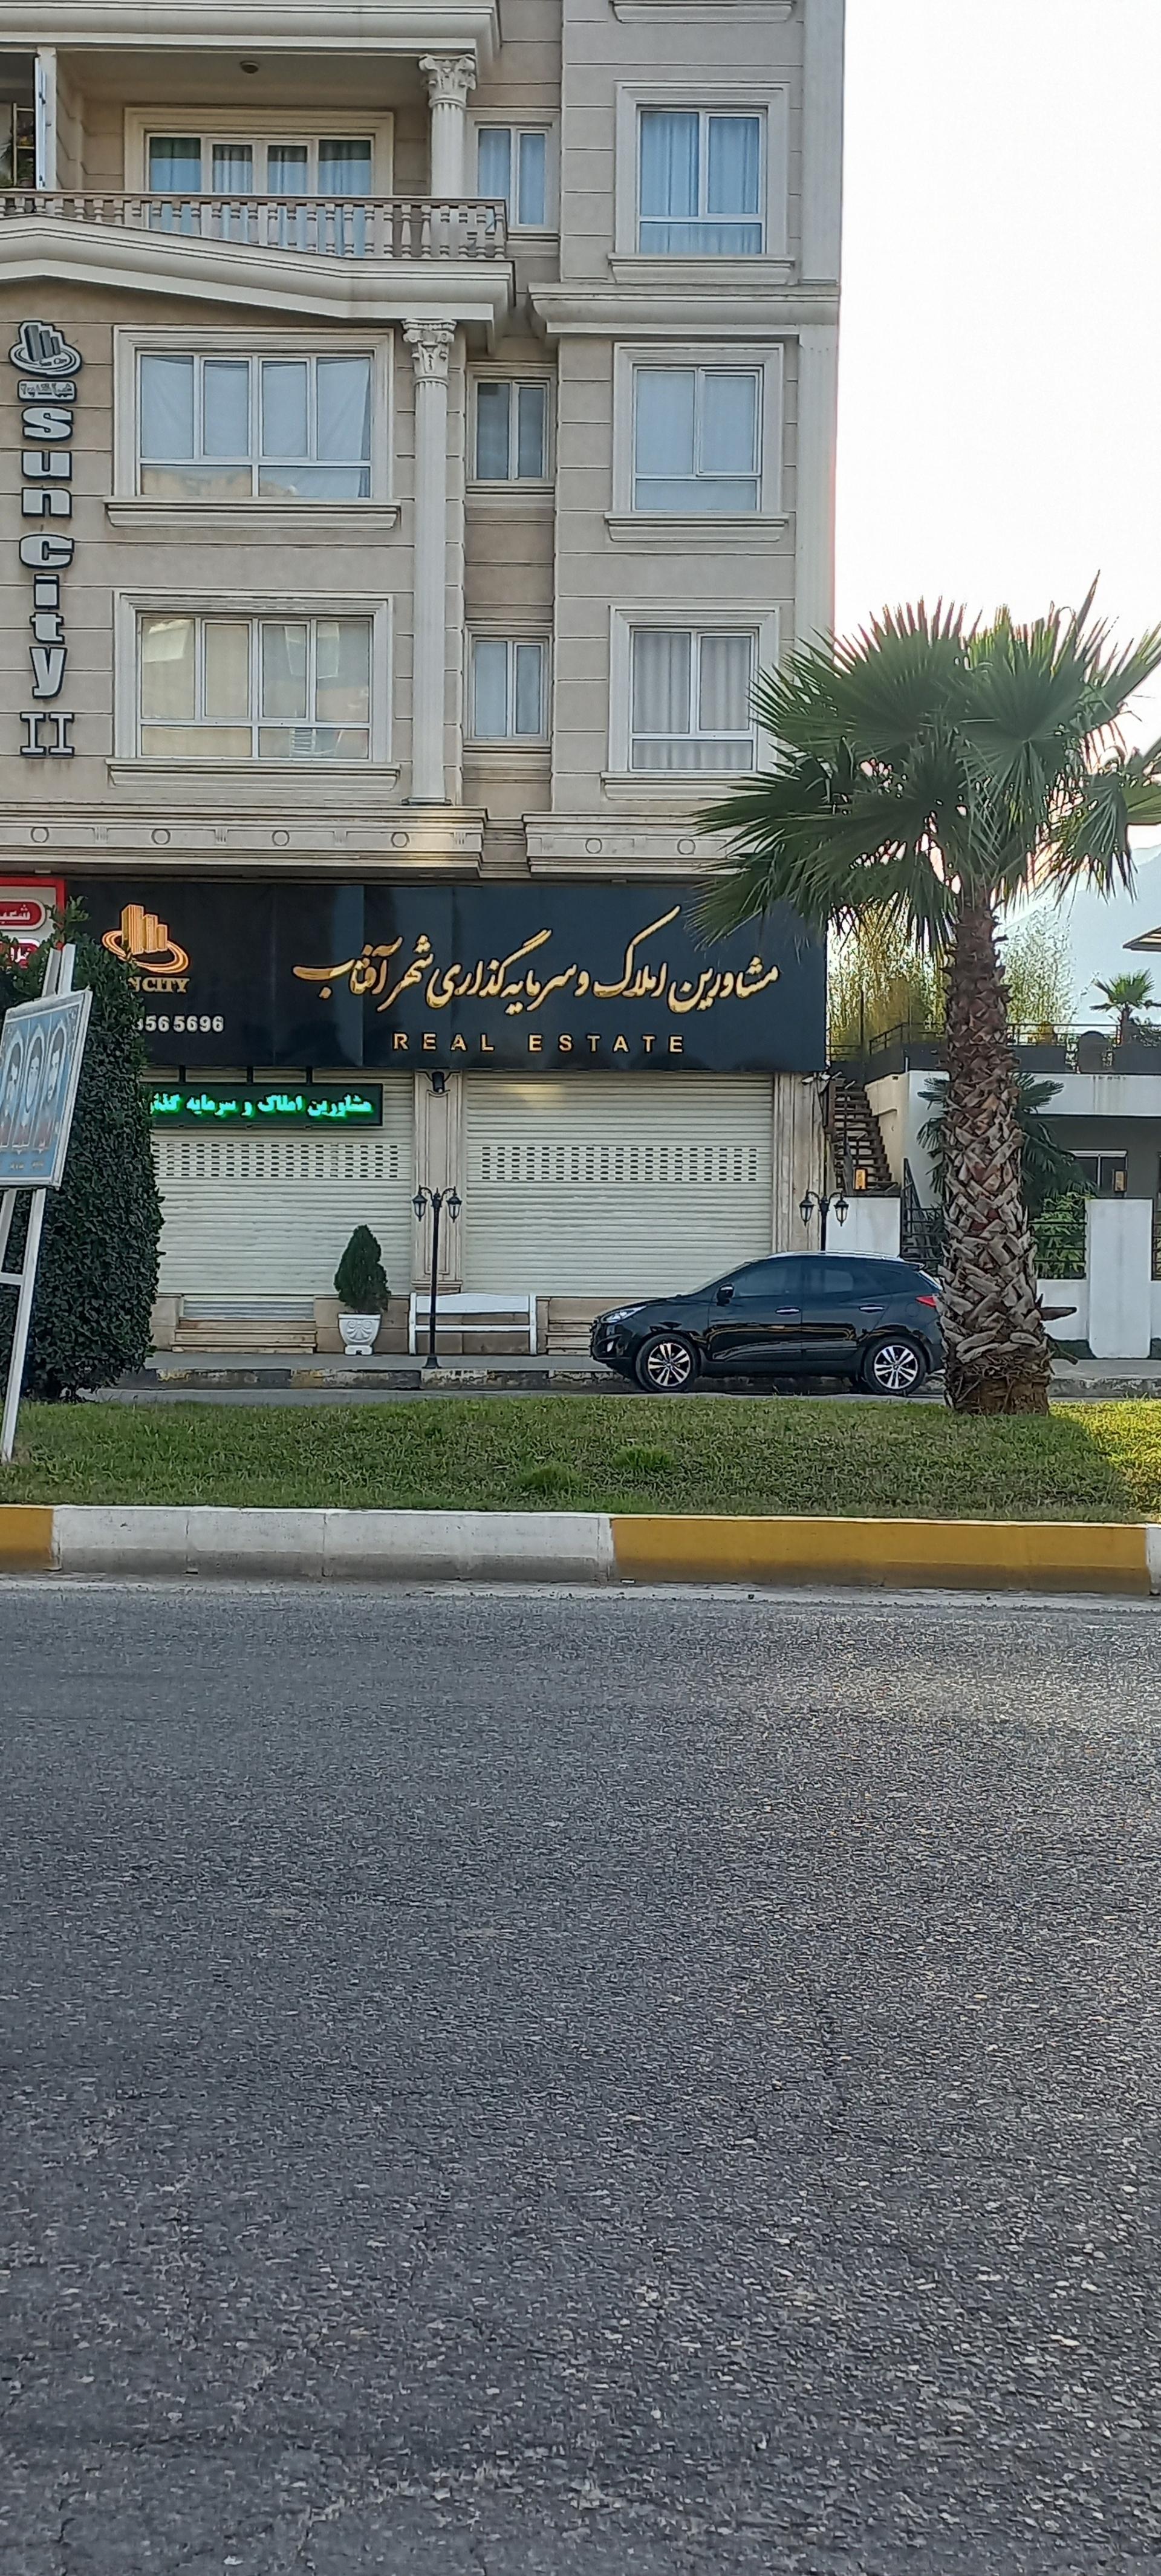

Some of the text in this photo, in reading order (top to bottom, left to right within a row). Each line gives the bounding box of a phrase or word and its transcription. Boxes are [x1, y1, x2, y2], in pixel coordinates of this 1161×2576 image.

[292, 936, 403, 1000] آفتاب
[593, 905, 681, 998] املاک
[377, 933, 434, 1012] شهر
[667, 956, 779, 1013] مشاورین
[393, 1032, 684, 1053] REAL ESTATE
[186, 1093, 236, 1116] سرمایه
[258, 1094, 303, 1112] املاک
[307, 1093, 372, 1117] مشاورین
